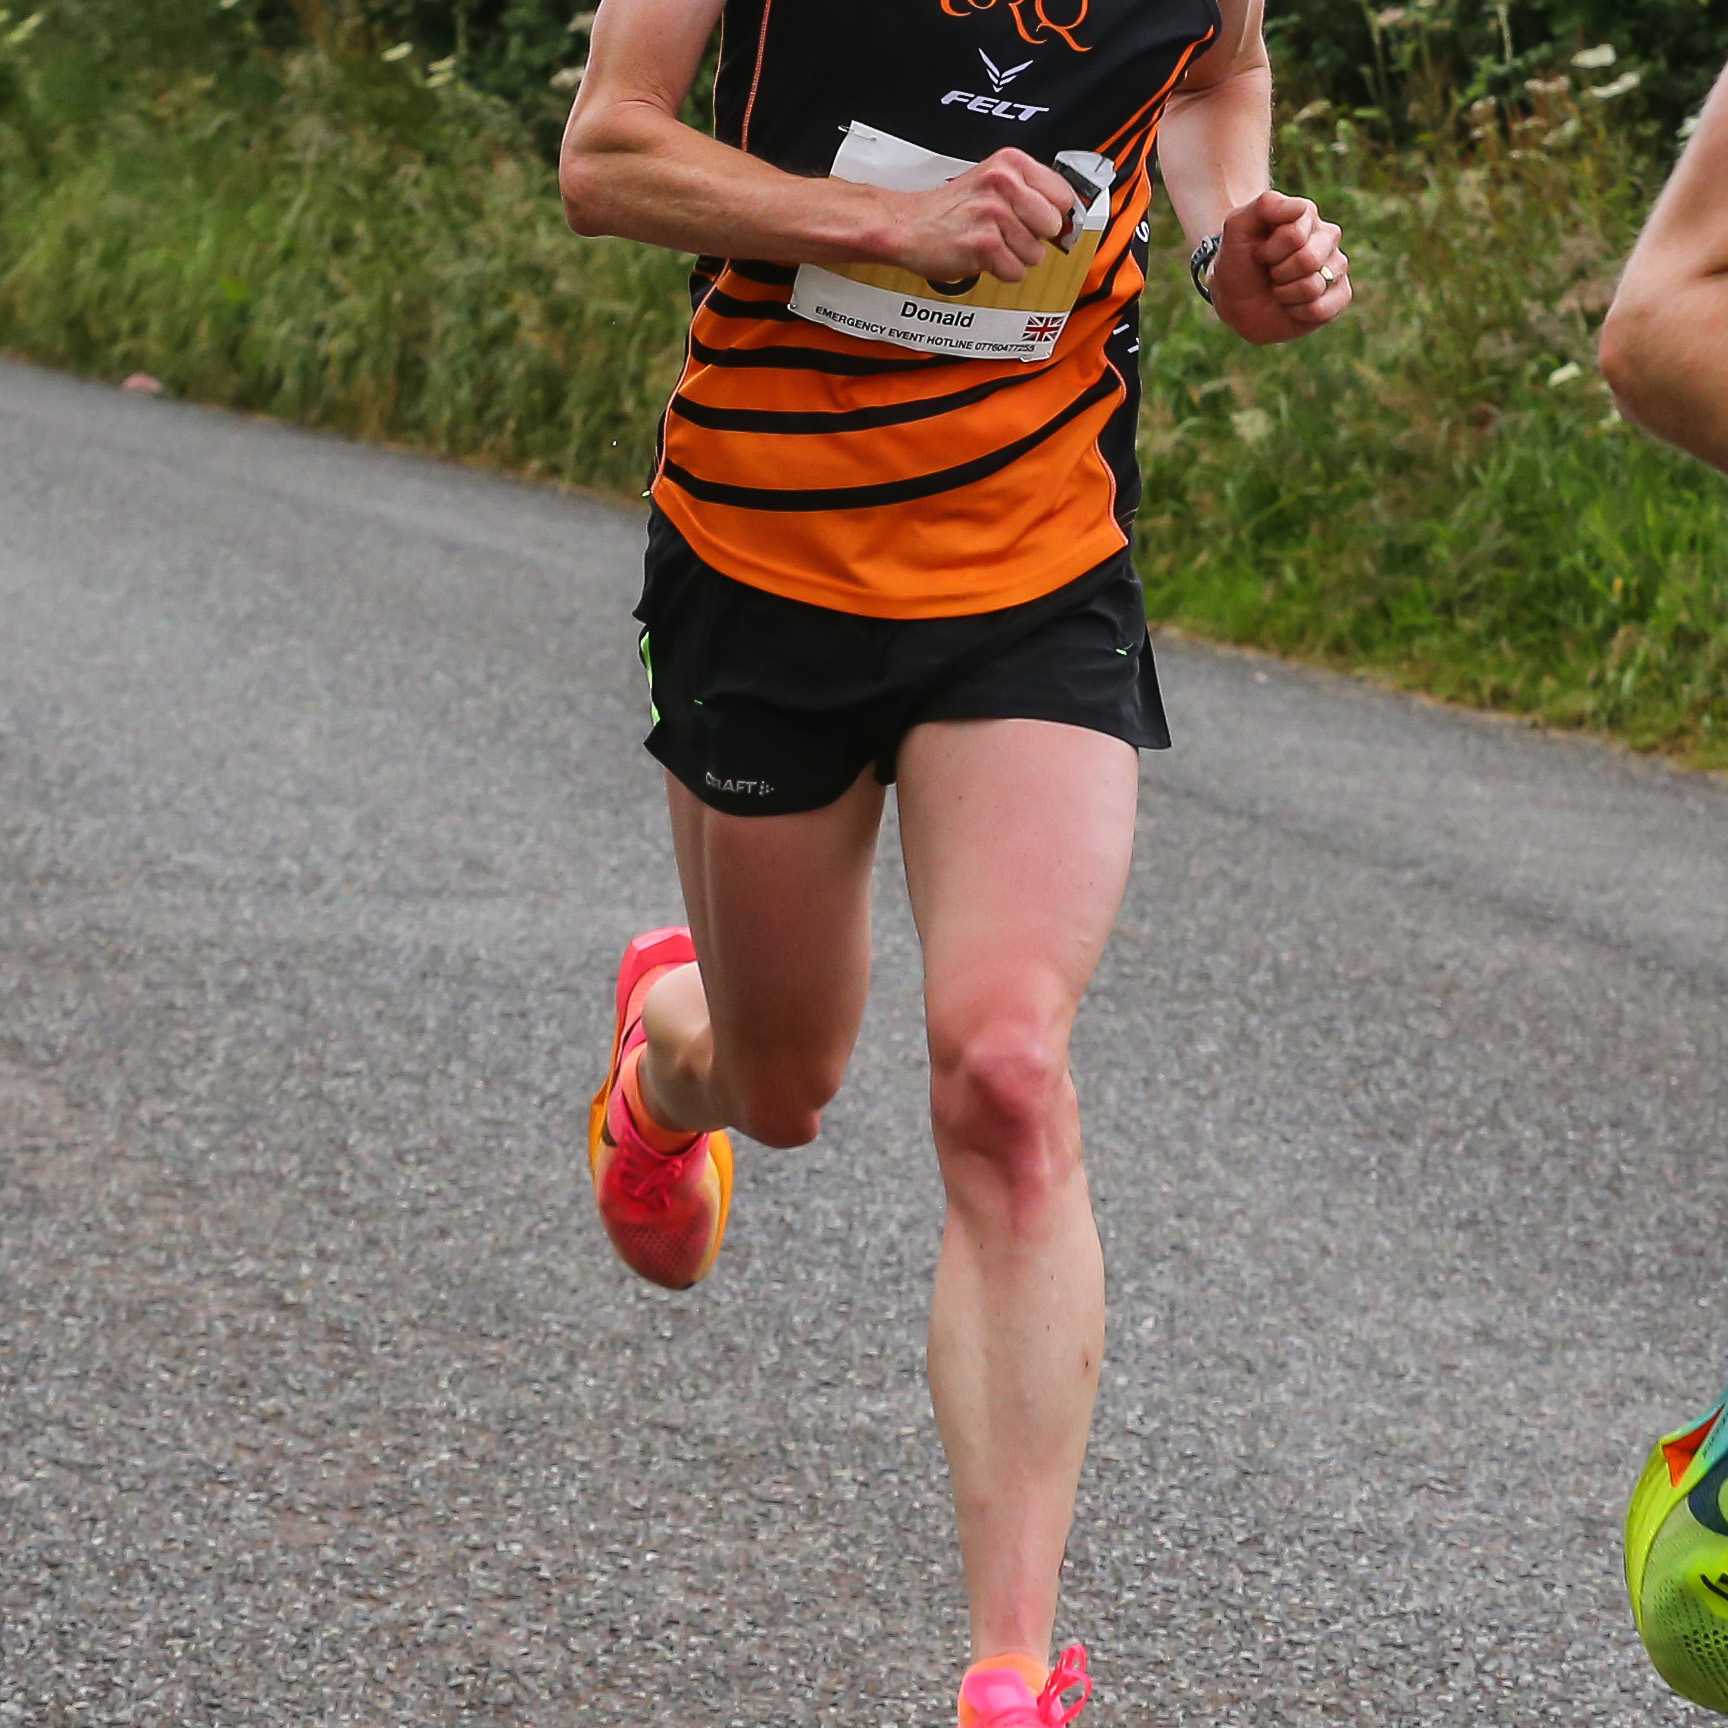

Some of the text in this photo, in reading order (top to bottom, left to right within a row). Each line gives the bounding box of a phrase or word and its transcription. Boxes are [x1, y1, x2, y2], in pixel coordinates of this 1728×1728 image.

[940, 90, 1050, 122] FELT
[815, 305, 887, 335] EMERGENCY
[888, 328, 926, 344] EVENT
[926, 335, 974, 351] HOTLINE
[900, 301, 975, 328] Donald
